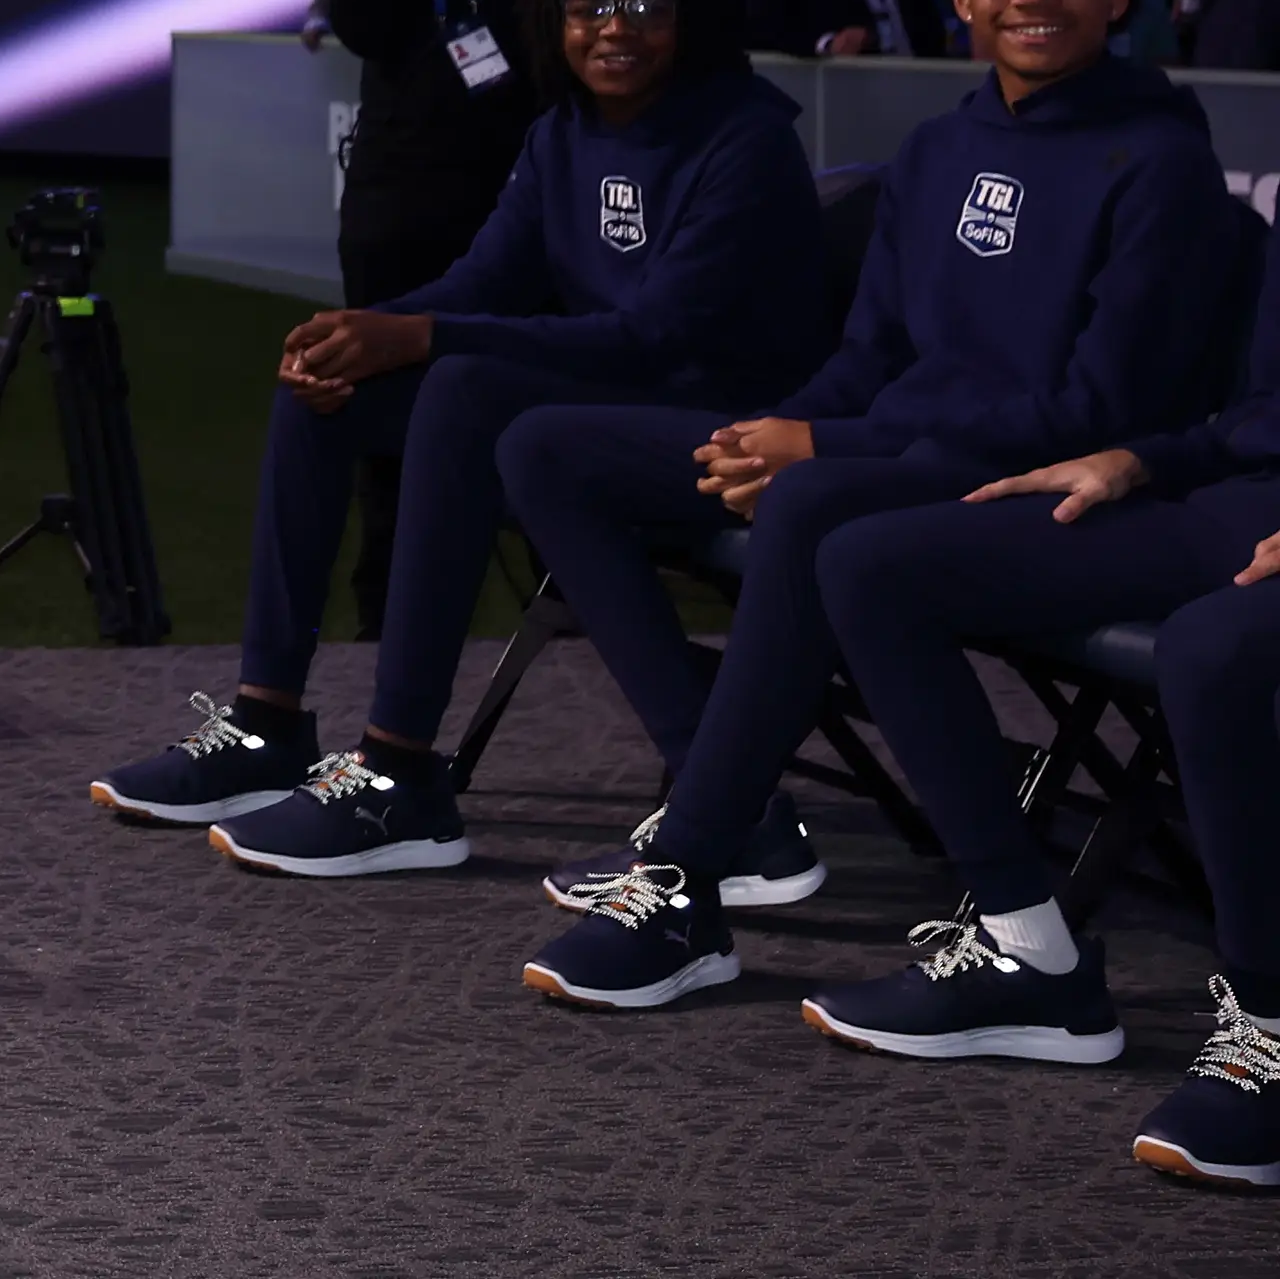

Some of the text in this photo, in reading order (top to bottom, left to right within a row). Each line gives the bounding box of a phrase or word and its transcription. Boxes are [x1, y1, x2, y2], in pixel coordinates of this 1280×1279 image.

[606, 182, 637, 210] TGL
[975, 179, 1014, 213] TGL
[964, 223, 994, 244] SoFi
